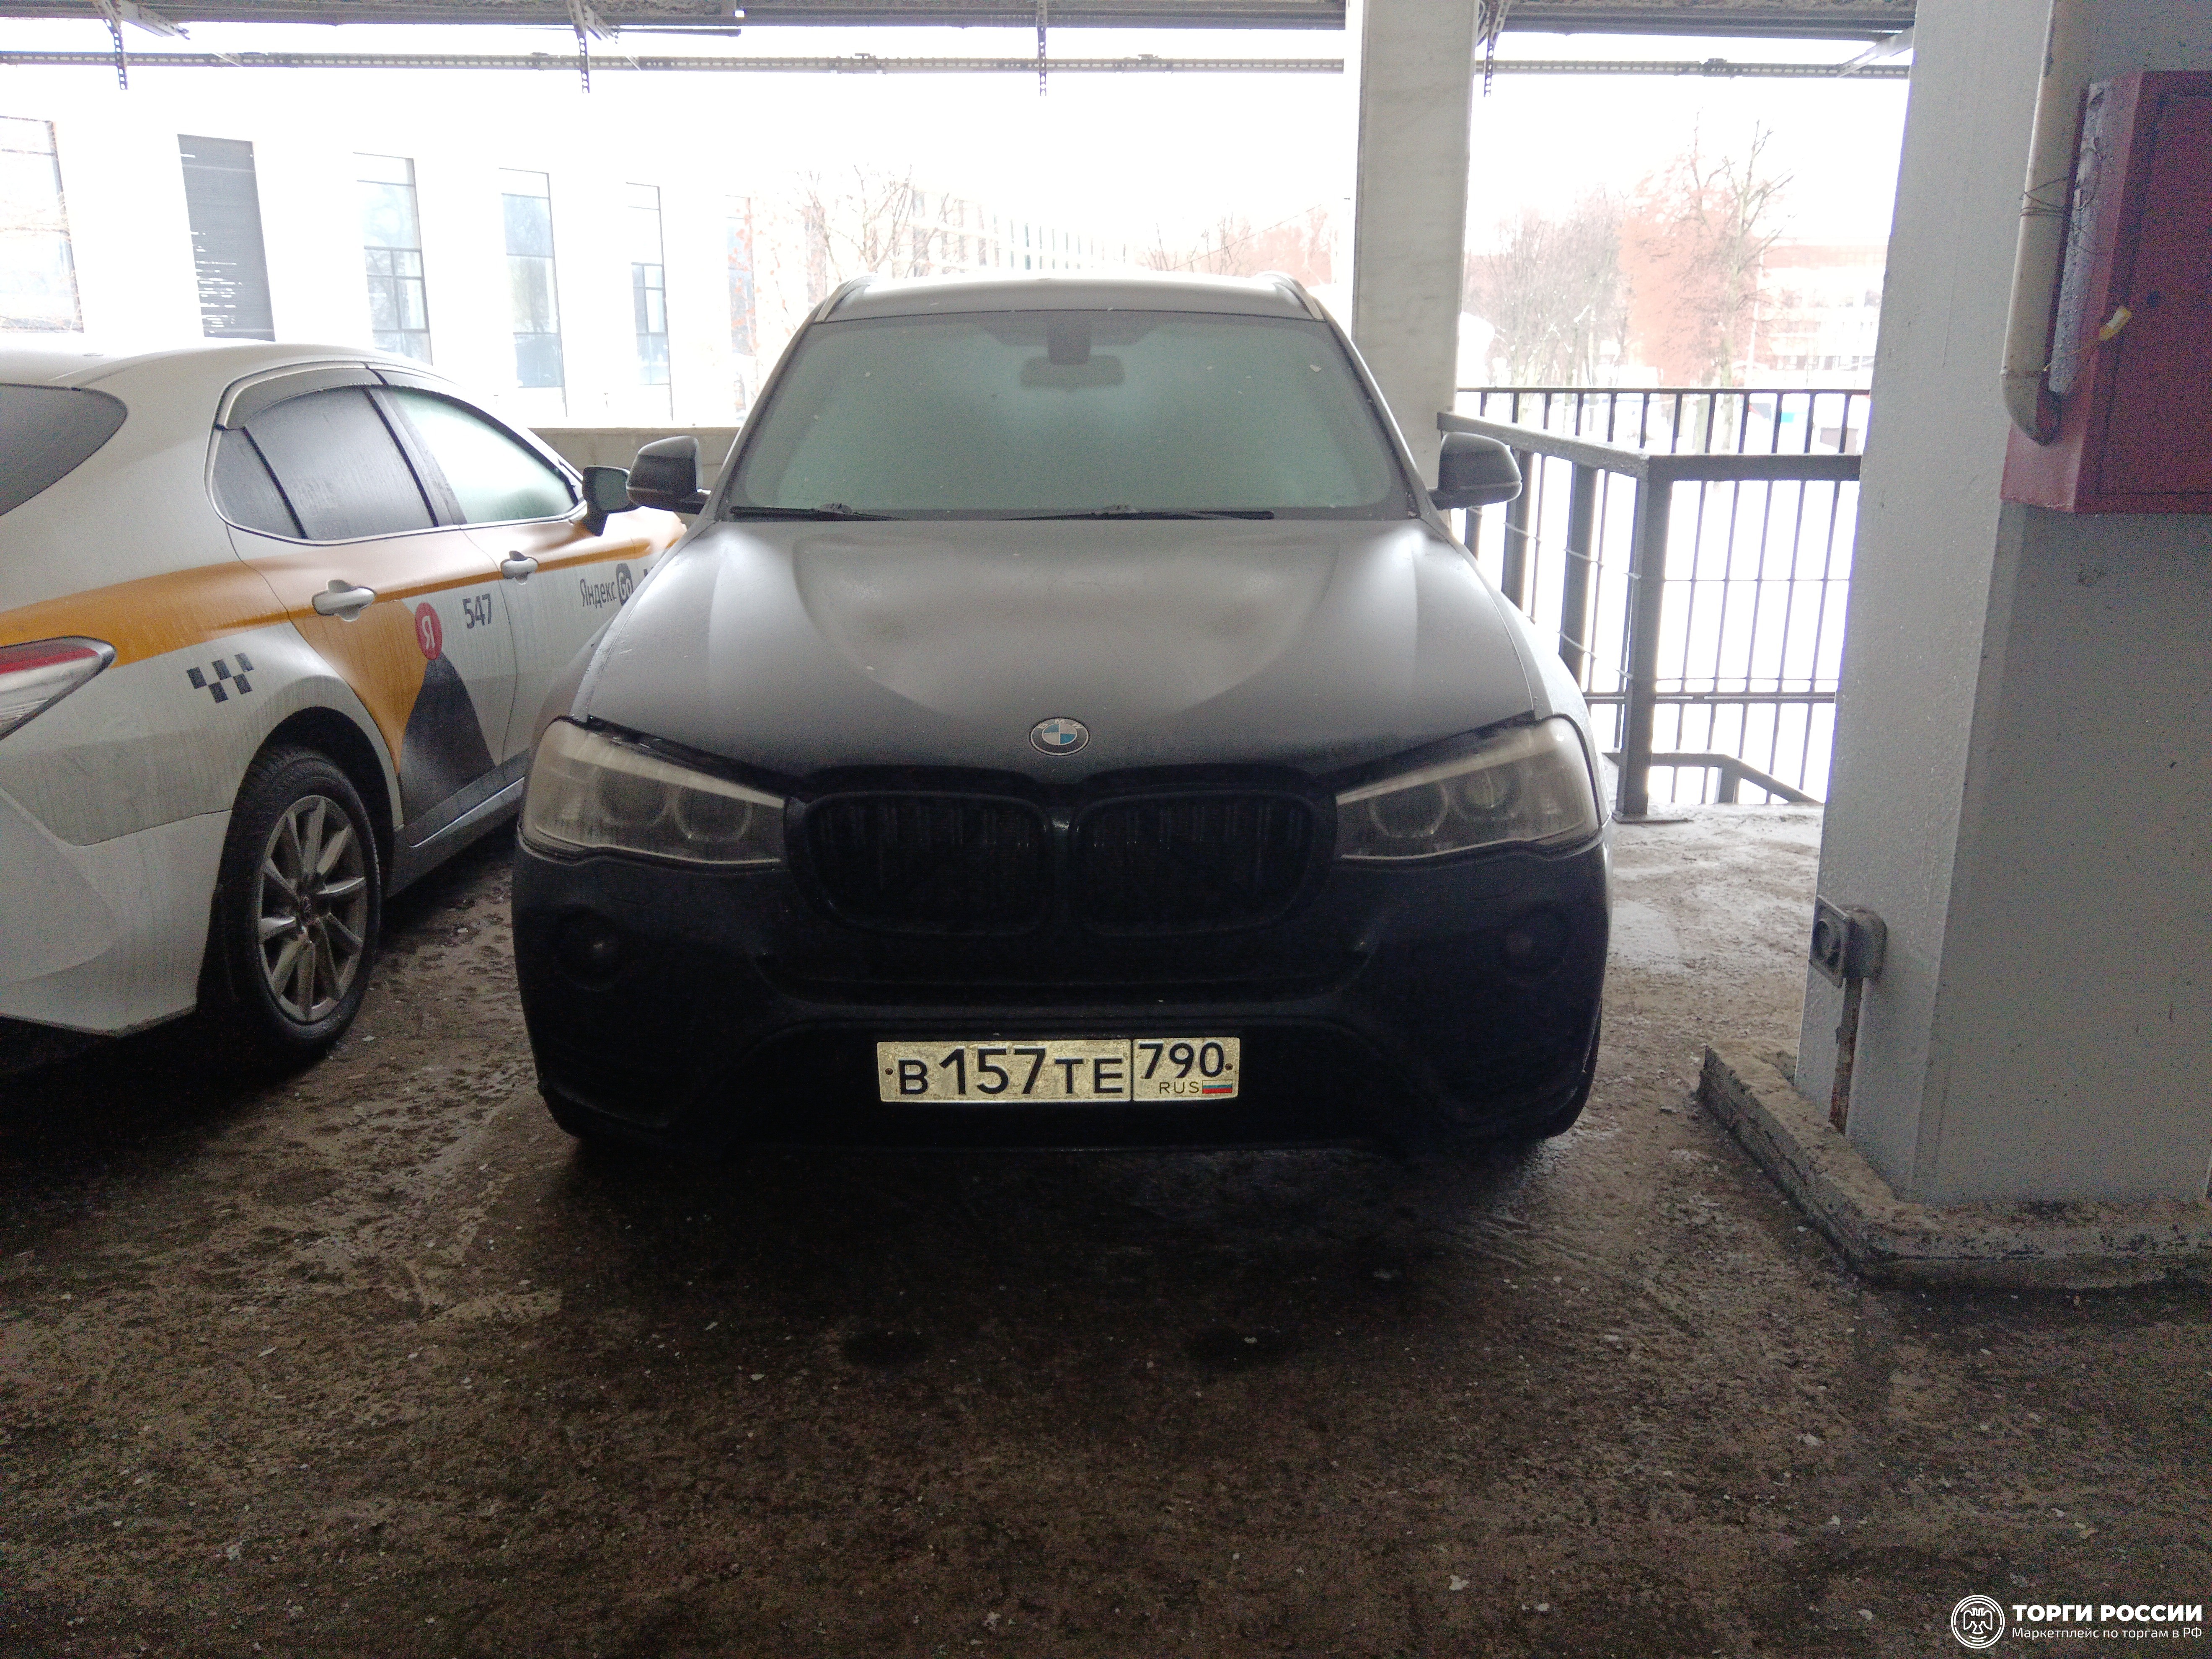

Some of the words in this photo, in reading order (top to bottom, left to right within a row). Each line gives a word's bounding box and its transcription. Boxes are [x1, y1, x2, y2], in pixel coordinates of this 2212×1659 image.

[580, 578, 615, 608] Яндекс
[463, 593, 492, 629] 547
[421, 615, 435, 649] Я
[1037, 718, 1083, 729] BMW
[1138, 1042, 1225, 1079] 790
[1159, 1081, 1199, 1094] RUS
